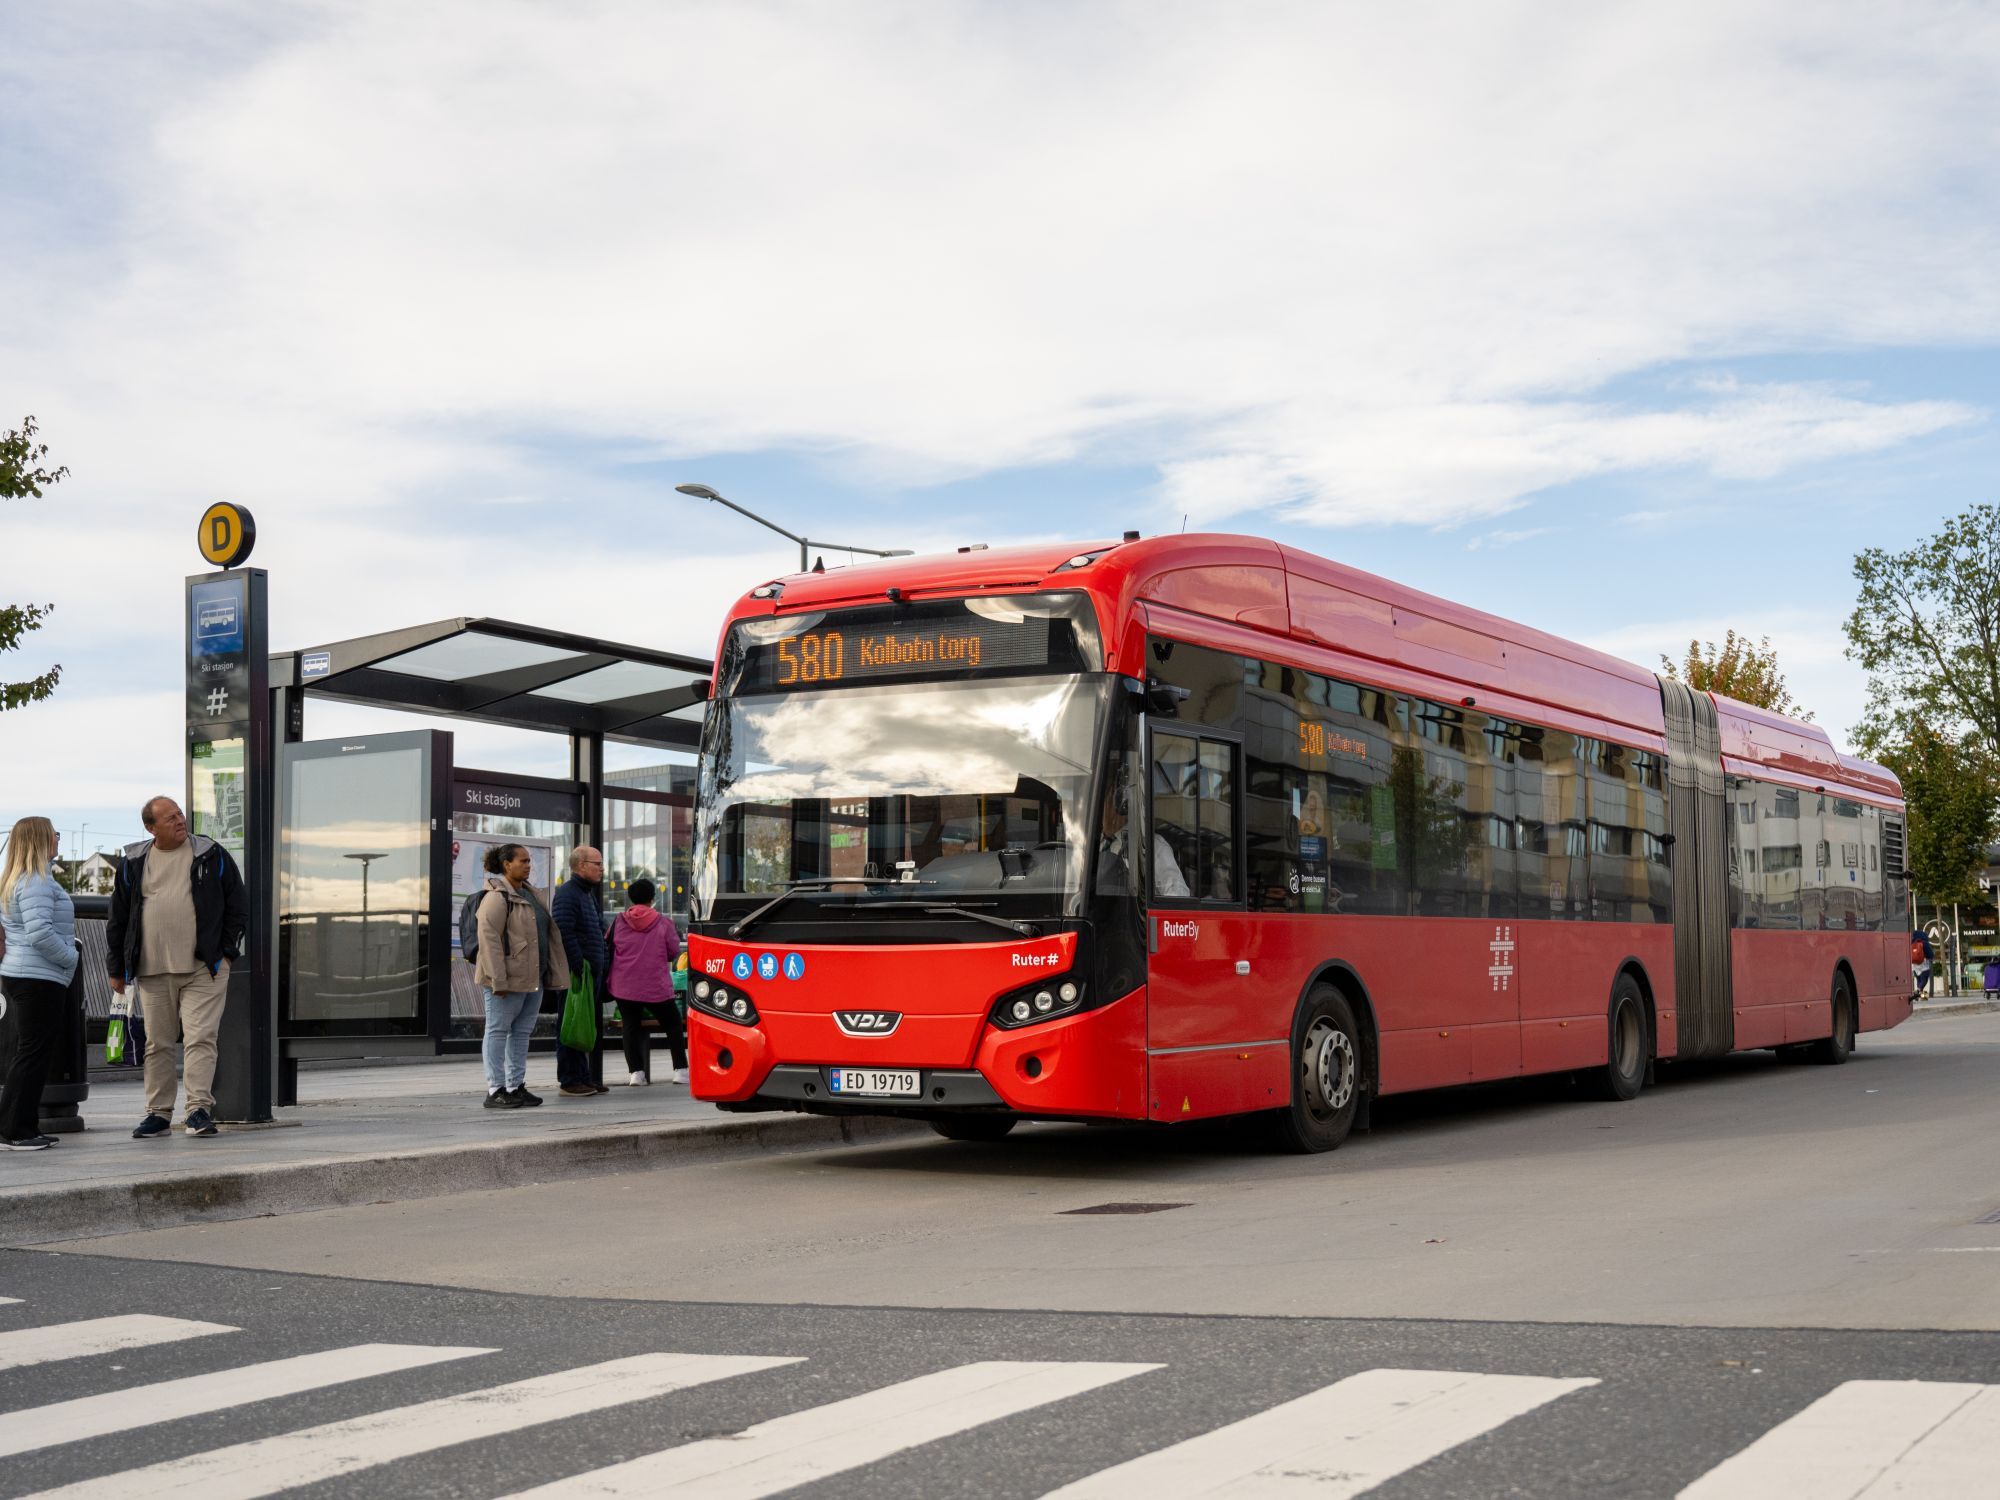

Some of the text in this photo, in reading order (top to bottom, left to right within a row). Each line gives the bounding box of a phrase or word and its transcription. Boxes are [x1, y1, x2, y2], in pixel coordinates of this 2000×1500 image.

[211, 515, 231, 552] D
[201, 663, 211, 673] Ski
[777, 632, 981, 685] 580 Kolbotn torg
[1300, 721, 1323, 755] 580
[466, 789, 521, 810] Ski stasjon
[1163, 920, 1200, 941] RuterBy
[706, 958, 726, 973] 8677
[844, 1013, 890, 1029] VDL
[846, 1073, 865, 1089] ED
[871, 1073, 914, 1091] 19719
